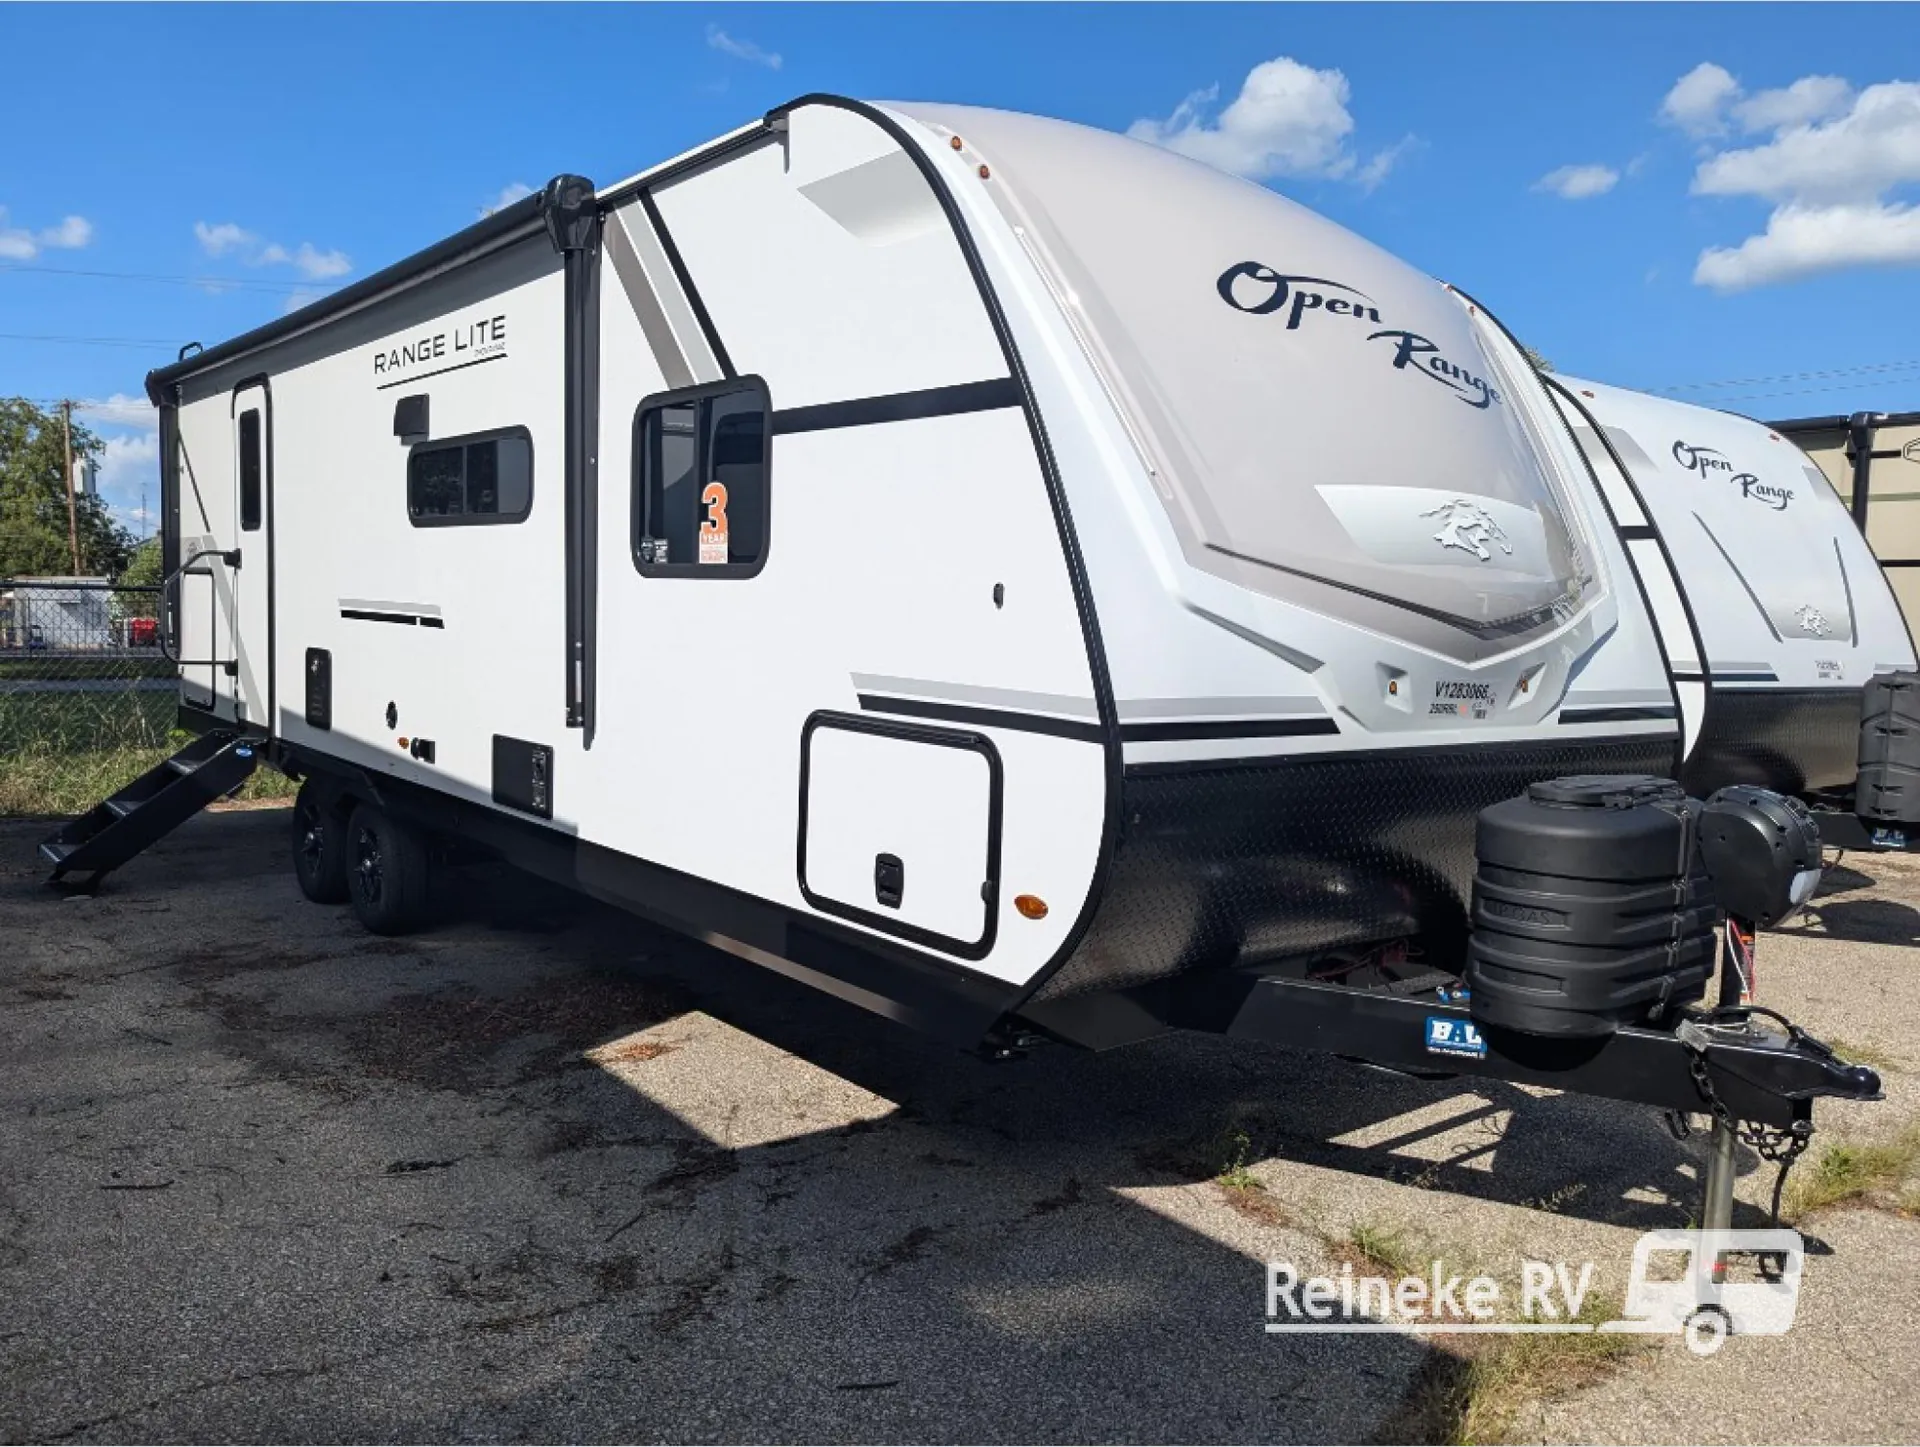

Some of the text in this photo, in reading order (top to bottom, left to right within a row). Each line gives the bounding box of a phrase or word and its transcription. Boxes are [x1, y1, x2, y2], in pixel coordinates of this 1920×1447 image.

[1217, 261, 1382, 329] Open
[374, 314, 505, 374] RANGE LITE
[1672, 440, 1733, 479] Open
[701, 482, 728, 533] 3
[1730, 473, 1795, 511] Range
